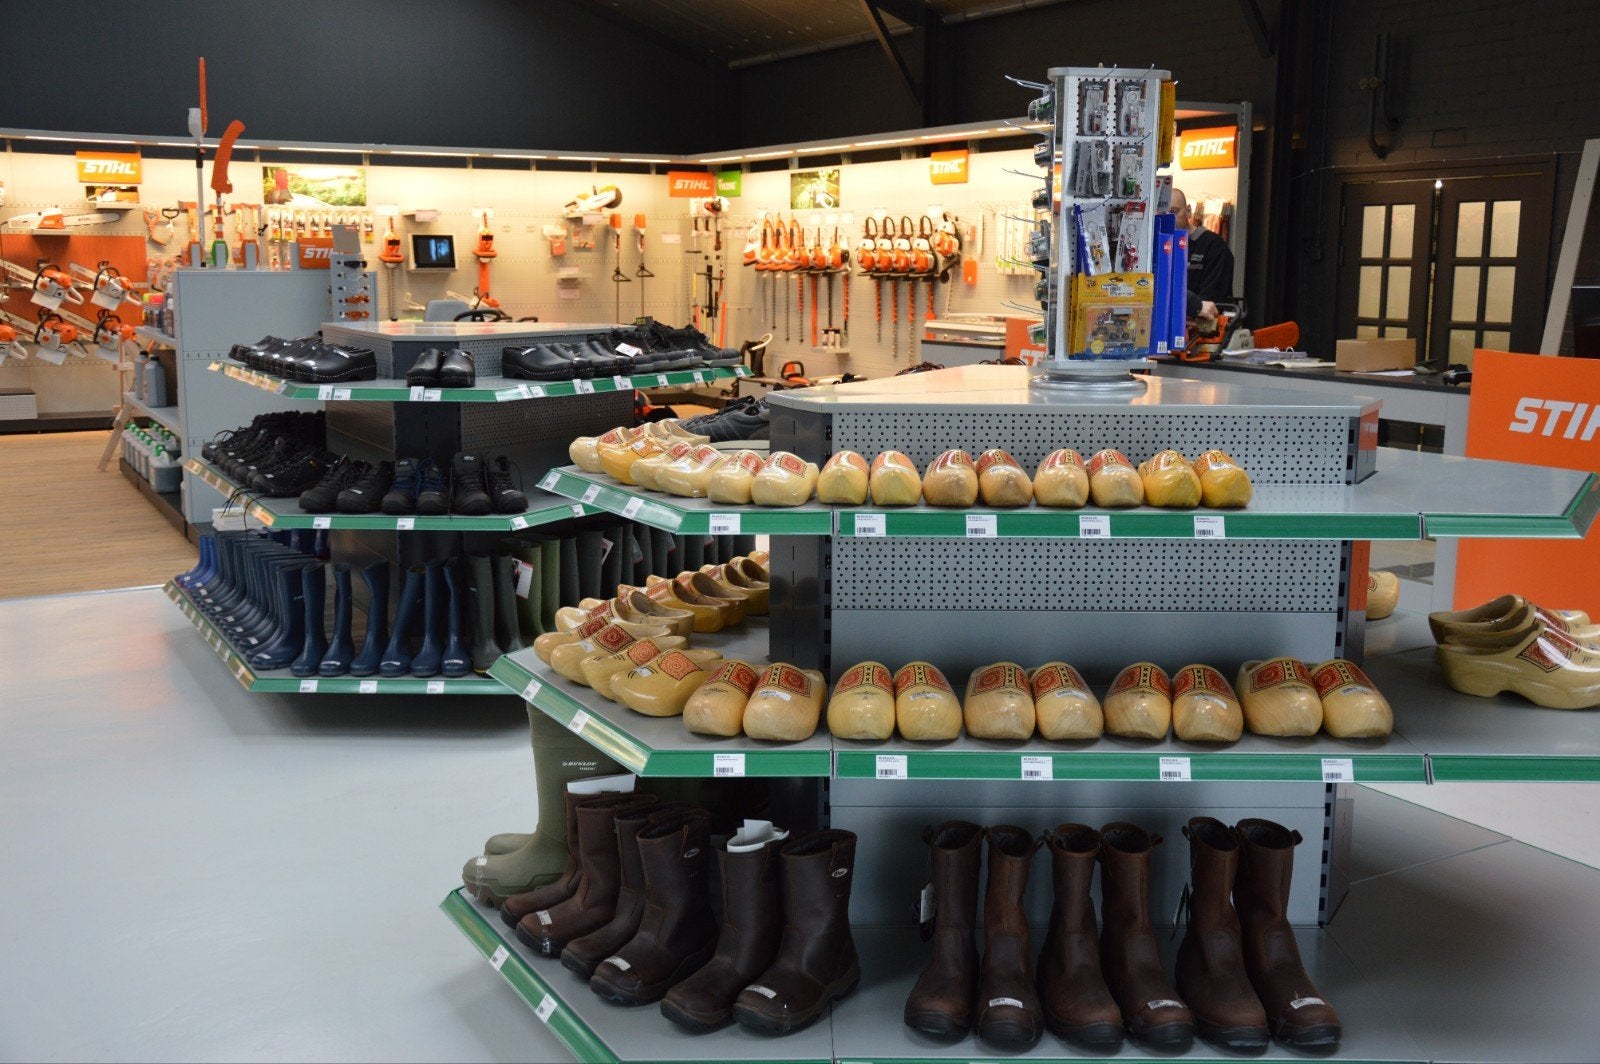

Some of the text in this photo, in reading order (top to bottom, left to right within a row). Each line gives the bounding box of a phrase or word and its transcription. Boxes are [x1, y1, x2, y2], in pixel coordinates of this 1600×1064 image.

[1183, 139, 1228, 157] STIHL
[84, 160, 136, 175] STIHL
[674, 179, 710, 190] STIHL
[303, 247, 336, 259] STI
